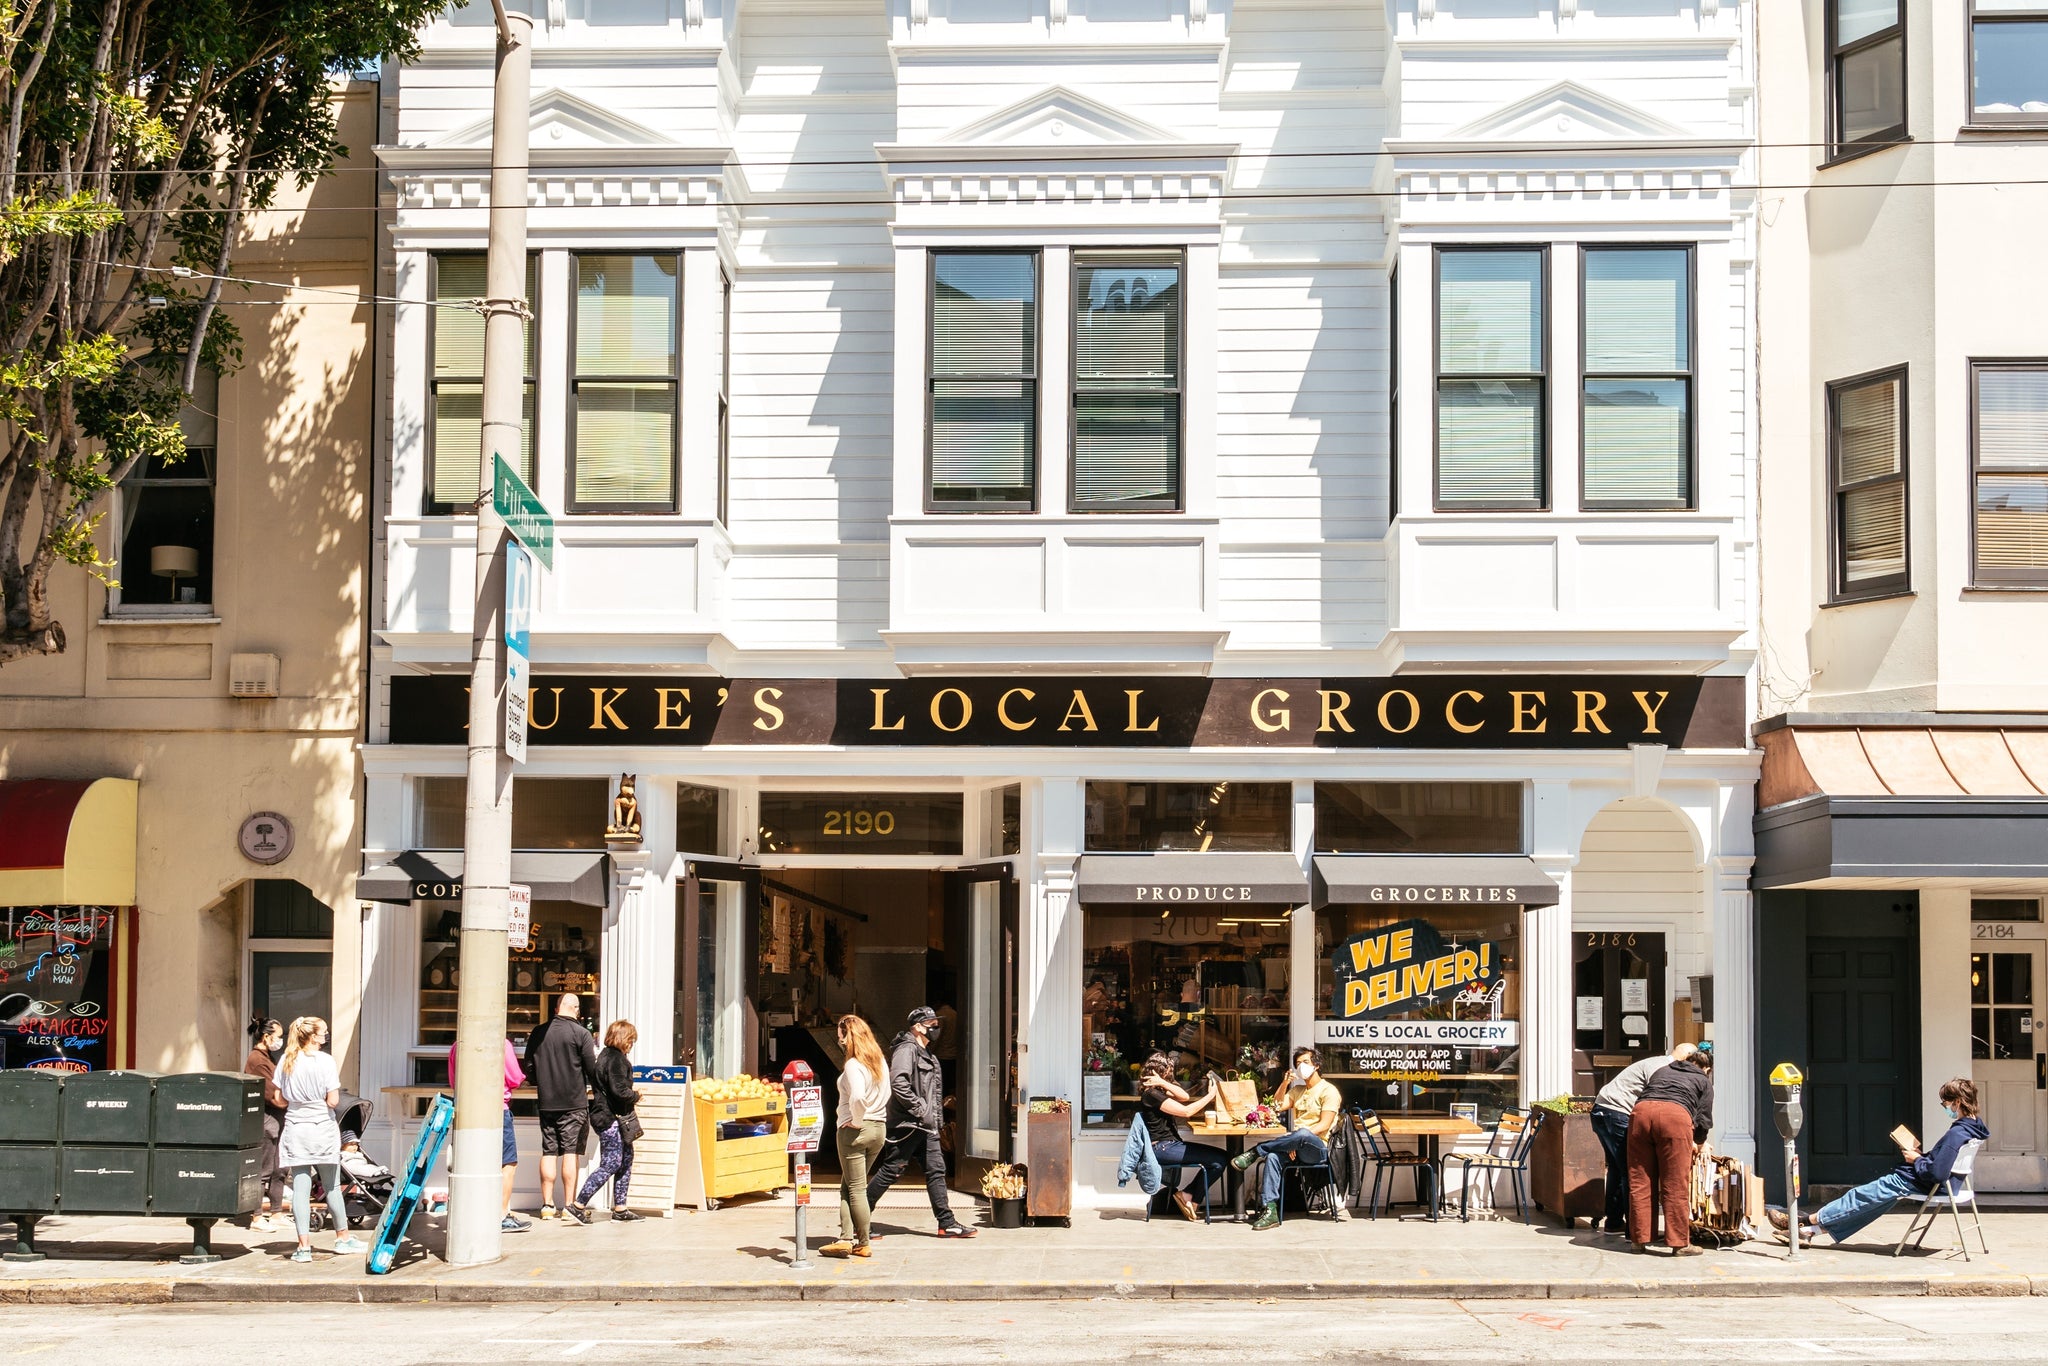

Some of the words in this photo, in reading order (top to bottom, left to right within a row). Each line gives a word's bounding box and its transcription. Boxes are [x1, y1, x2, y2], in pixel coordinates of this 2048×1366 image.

[503, 477, 545, 548] Fillmore
[508, 687, 526, 711] Lombard
[463, 687, 785, 731] UKE'S
[869, 688, 1160, 732] LOCAL
[1250, 688, 1669, 734] GROCERY
[508, 705, 521, 727] Street
[823, 810, 895, 836] 2190
[416, 883, 462, 897] COF
[1136, 886, 1253, 901] PRODUCE
[1370, 887, 1518, 902] GROCERIES
[1976, 924, 2015, 938] 2184
[1587, 932, 1636, 947] 2186
[1350, 927, 1414, 973] WE
[53, 964, 76, 975] BUD
[53, 975, 74, 985] MAN
[1344, 942, 1491, 1018] DELIVER!
[18, 1016, 109, 1036] SPEAKEASY
[1327, 1023, 1379, 1038] LUKE'S
[1385, 1026, 1432, 1038] LOCAL
[1437, 1026, 1507, 1039] GROCERY
[27, 1036, 50, 1045] ALES
[52, 1036, 60, 1046] &
[1352, 1048, 1404, 1059] DOWNLOAD
[1405, 1049, 1428, 1060] OUR
[1430, 1049, 1450, 1060] APP
[1454, 1049, 1463, 1060] &
[1360, 1059, 1387, 1070] SHOP
[1391, 1060, 1418, 1070] FROM
[1422, 1060, 1451, 1070] HOME
[1370, 1070, 1441, 1081] #LIKEALOCAL
[98, 1101, 128, 1109] WEEKLY
